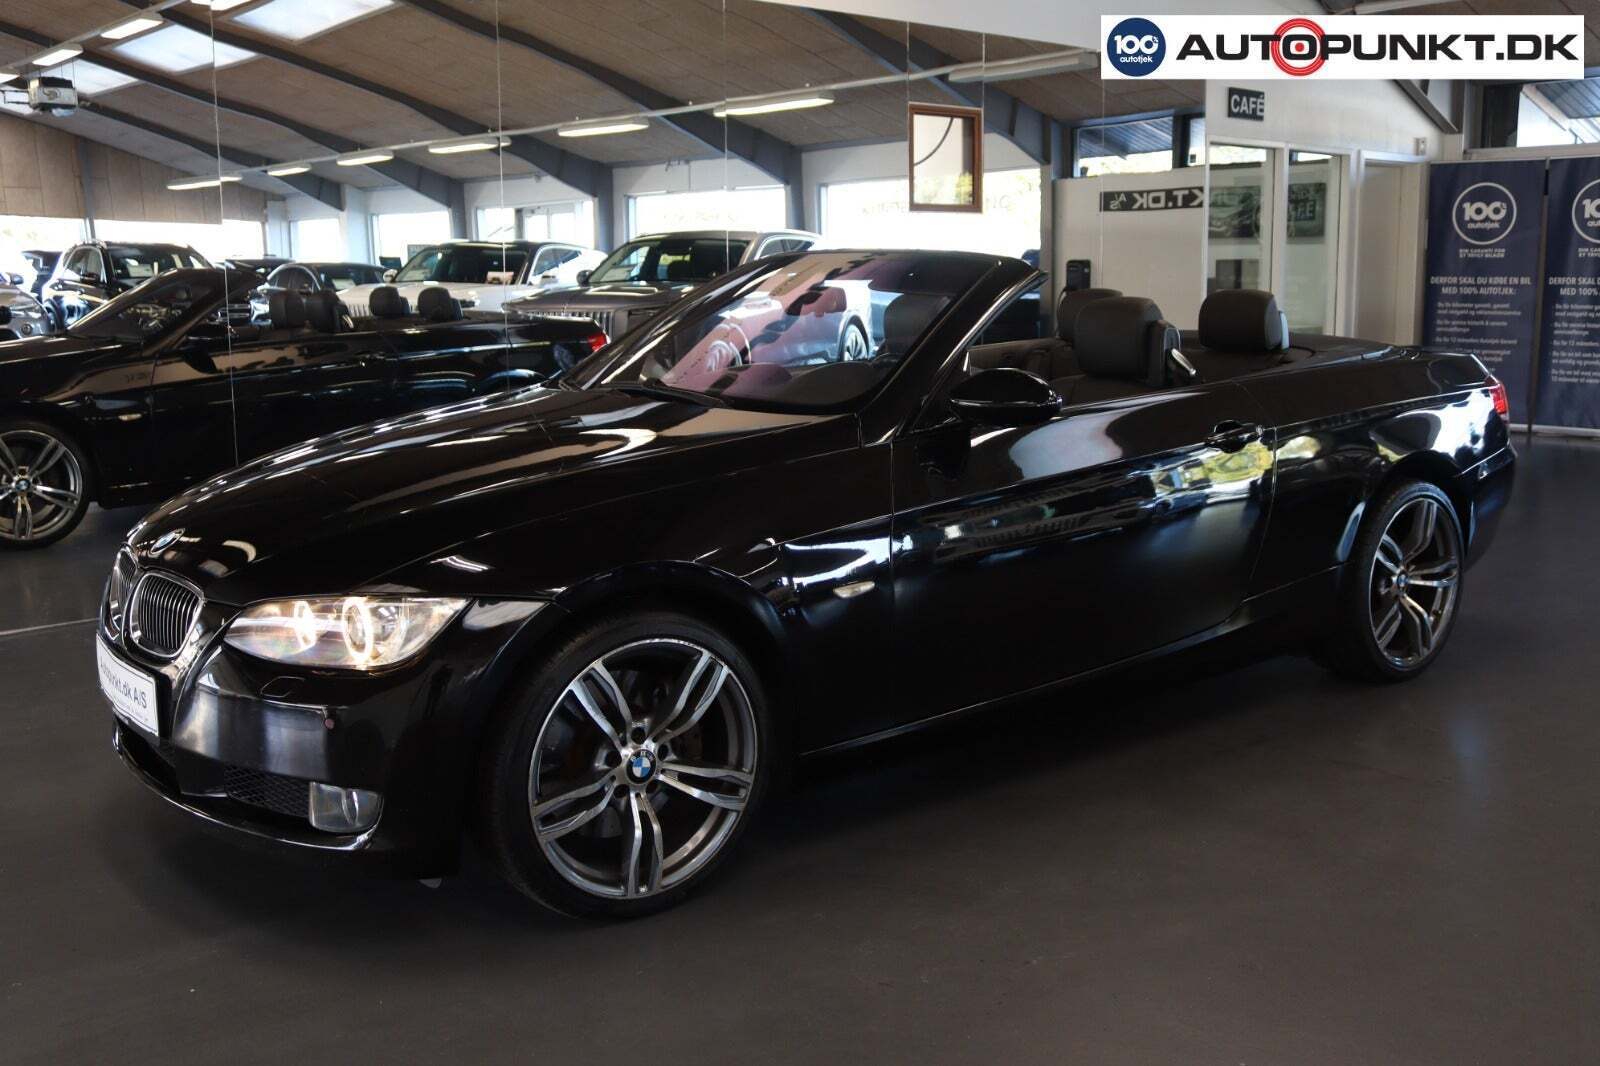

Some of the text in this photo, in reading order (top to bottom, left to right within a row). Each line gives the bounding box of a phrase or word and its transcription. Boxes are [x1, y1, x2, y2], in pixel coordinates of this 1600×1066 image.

[1230, 95, 1265, 115] CAFÉ
[1430, 276, 1458, 285] DERFOR
[1459, 276, 1475, 285] SKAL
[1477, 276, 1487, 285] DU
[1509, 276, 1519, 285] EN
[1520, 277, 1531, 285] BIL
[1549, 277, 1576, 285] DERFOR
[1577, 277, 1596, 285] SKAL
[1442, 287, 1458, 295] MED
[1459, 287, 1478, 295] 100%
[1560, 287, 1598, 296] MED 100%
